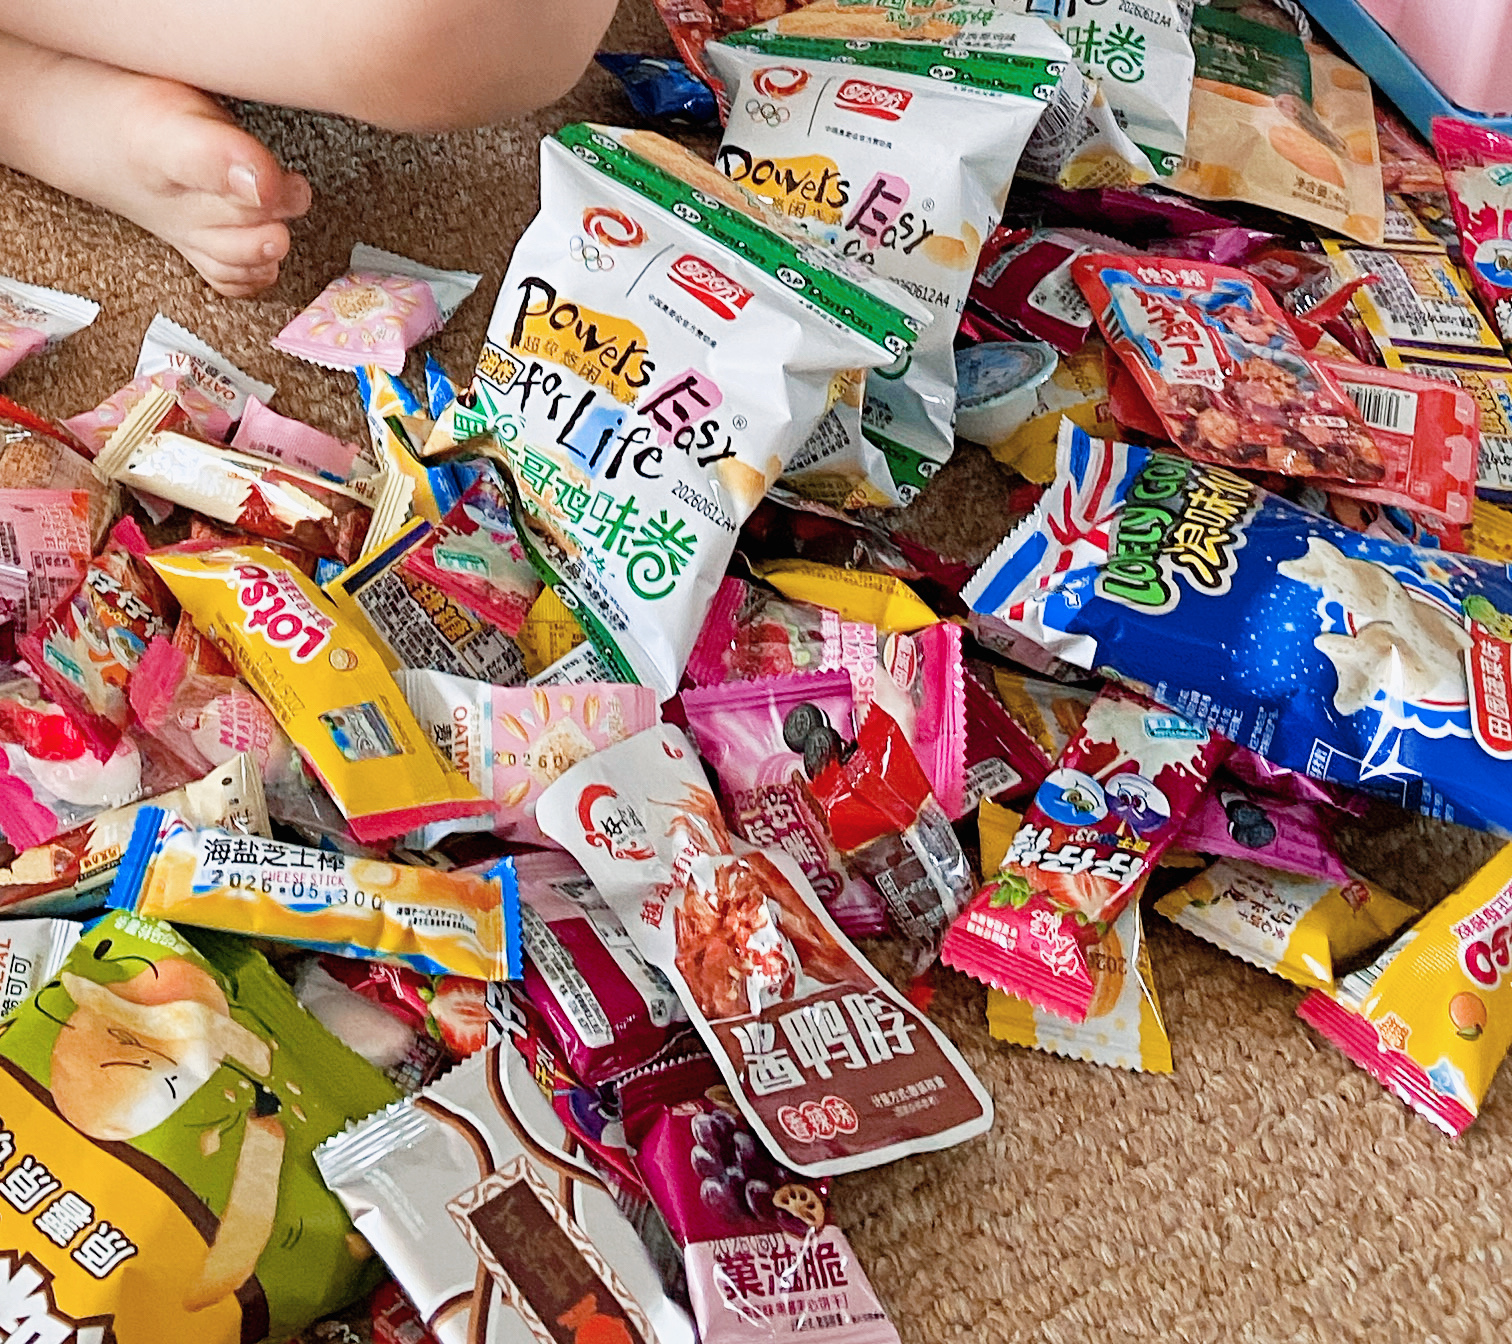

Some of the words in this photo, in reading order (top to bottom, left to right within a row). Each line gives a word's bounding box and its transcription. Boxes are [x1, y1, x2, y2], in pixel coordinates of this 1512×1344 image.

[510, 275, 657, 389] Powers
[515, 361, 572, 421] for
[555, 389, 665, 481] Life
[637, 375, 738, 469] Easy
[203, 837, 347, 872] 海盐芝士棒
